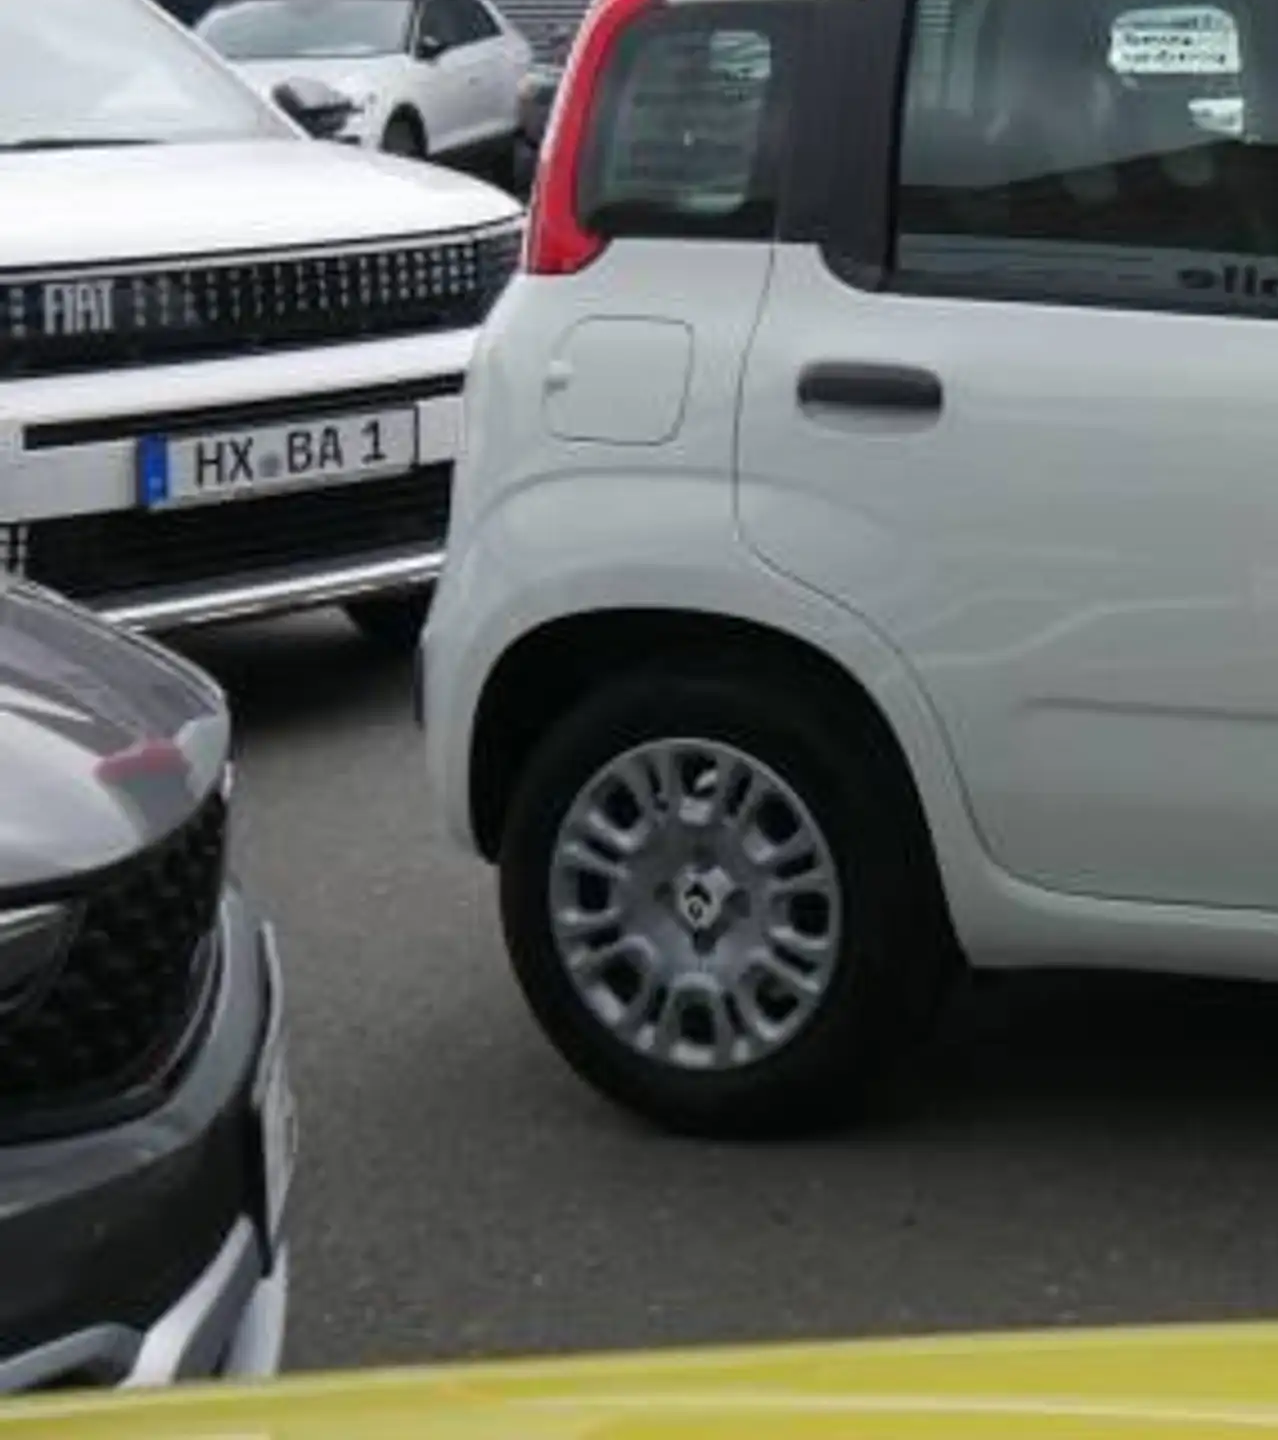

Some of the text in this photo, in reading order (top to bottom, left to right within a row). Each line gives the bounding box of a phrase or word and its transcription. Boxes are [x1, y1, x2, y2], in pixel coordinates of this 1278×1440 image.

[44, 279, 114, 335] FIAT
[195, 419, 386, 487] HX BA 1
